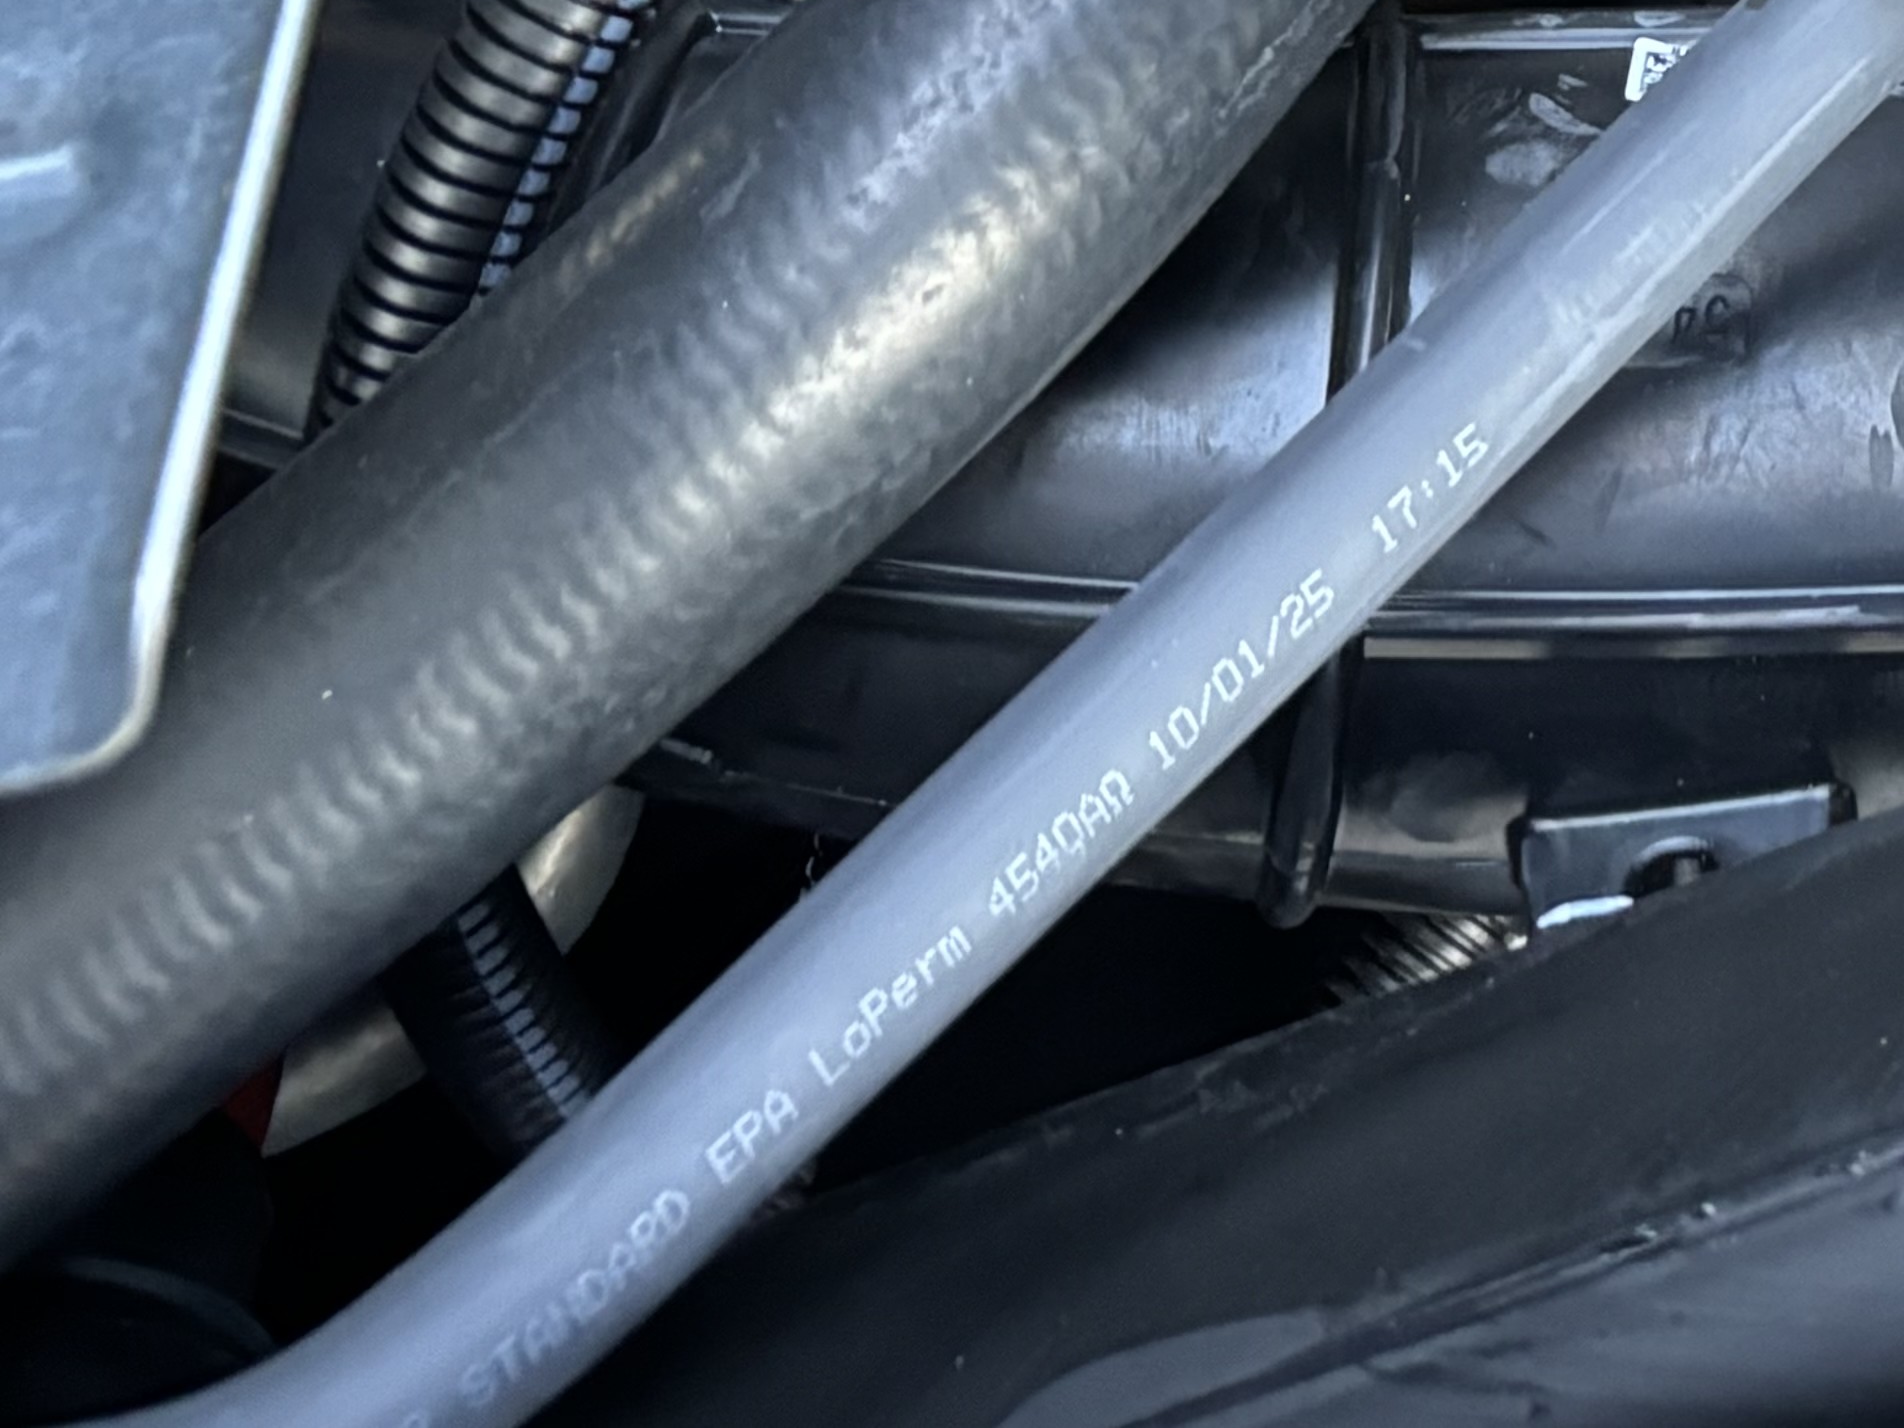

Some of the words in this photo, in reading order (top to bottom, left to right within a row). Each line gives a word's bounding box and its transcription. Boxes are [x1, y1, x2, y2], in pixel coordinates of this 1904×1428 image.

[461, 1188, 691, 1410] STANDARD
[705, 1088, 802, 1187] EPA
[811, 924, 973, 1085] LoPerm
[1147, 571, 1337, 771] 10/01/25
[1369, 424, 1492, 555] 17:15
